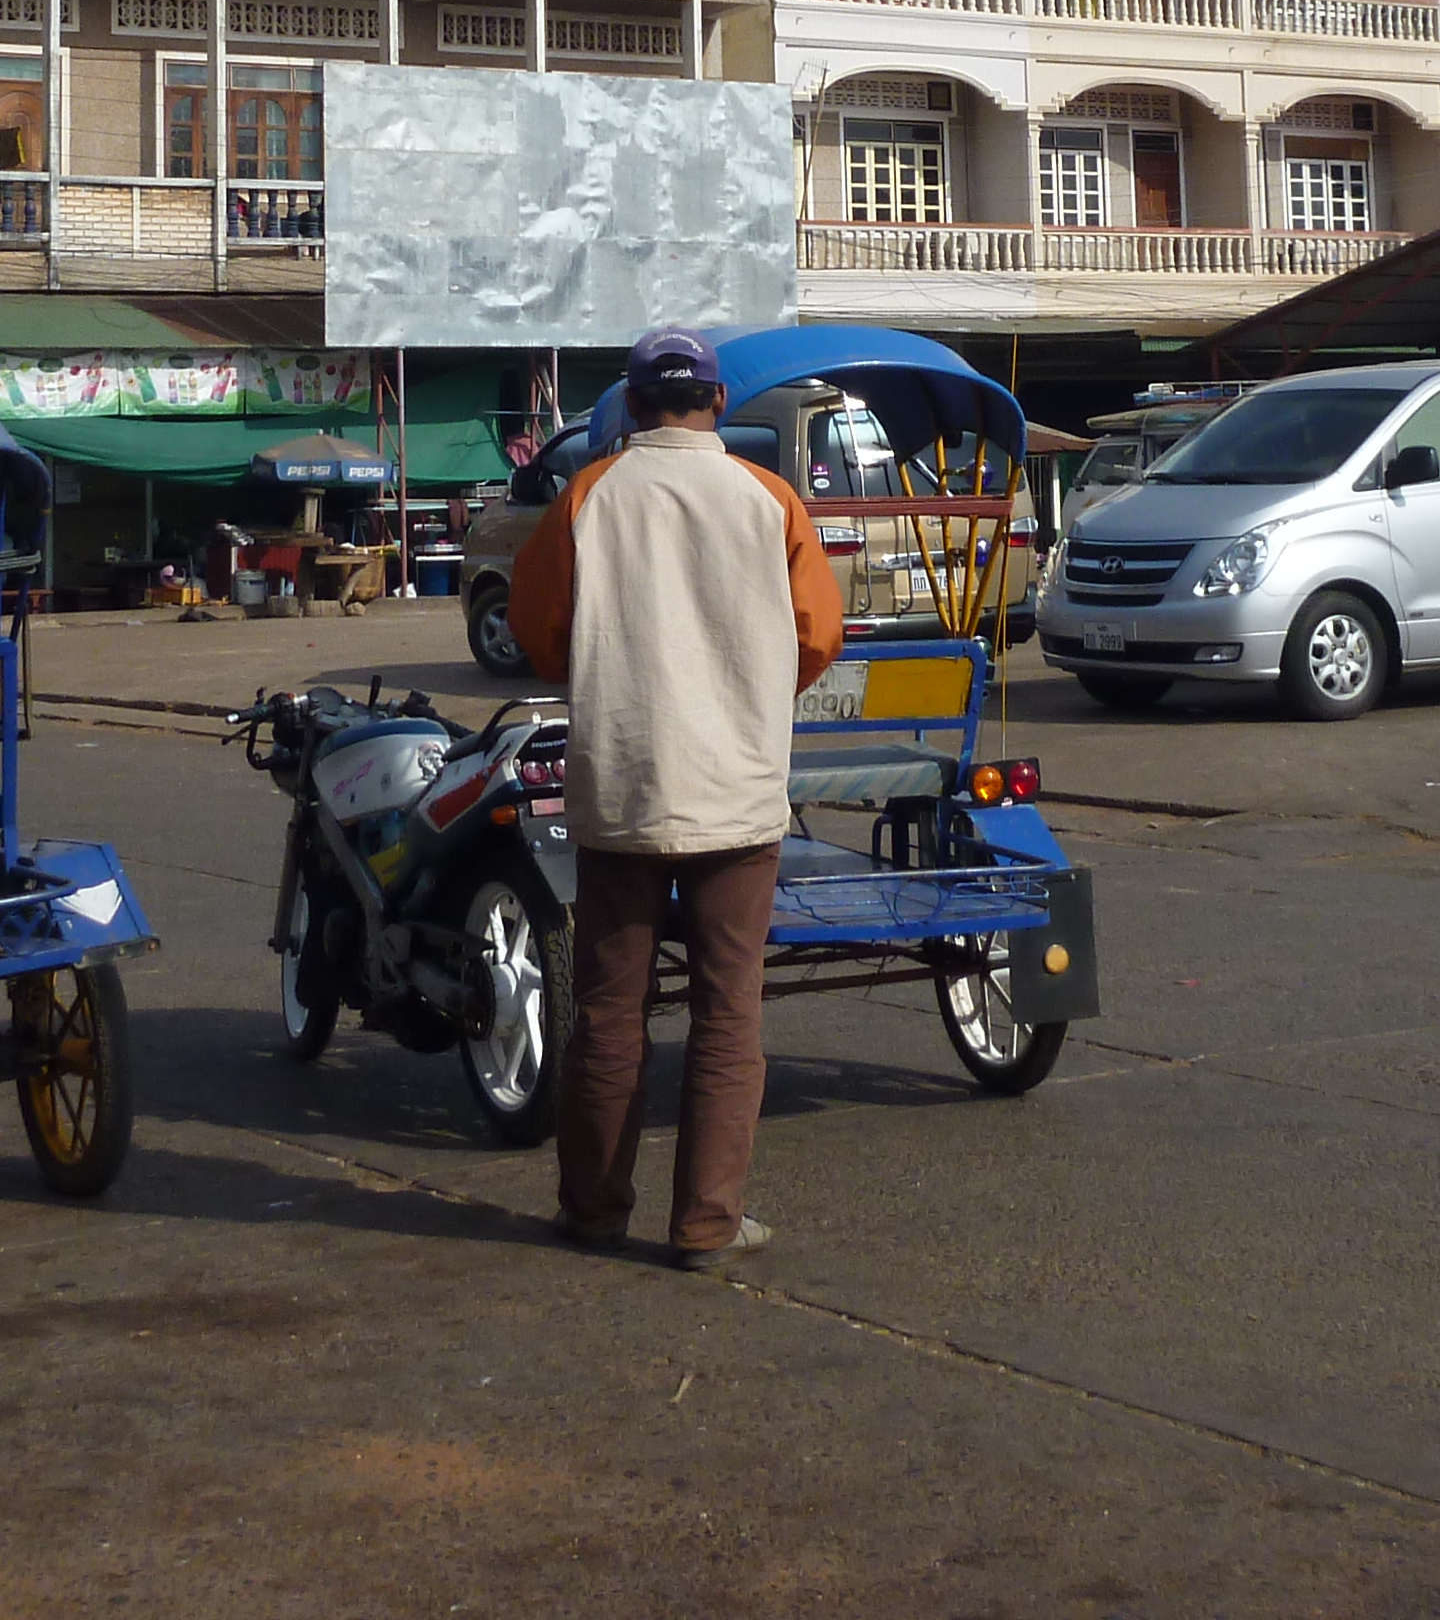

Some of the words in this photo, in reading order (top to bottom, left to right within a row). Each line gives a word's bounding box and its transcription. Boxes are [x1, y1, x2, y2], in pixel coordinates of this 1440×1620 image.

[661, 368, 693, 379] NOKIA
[287, 465, 331, 476] PEPSI
[349, 467, 384, 478] PEPSI
